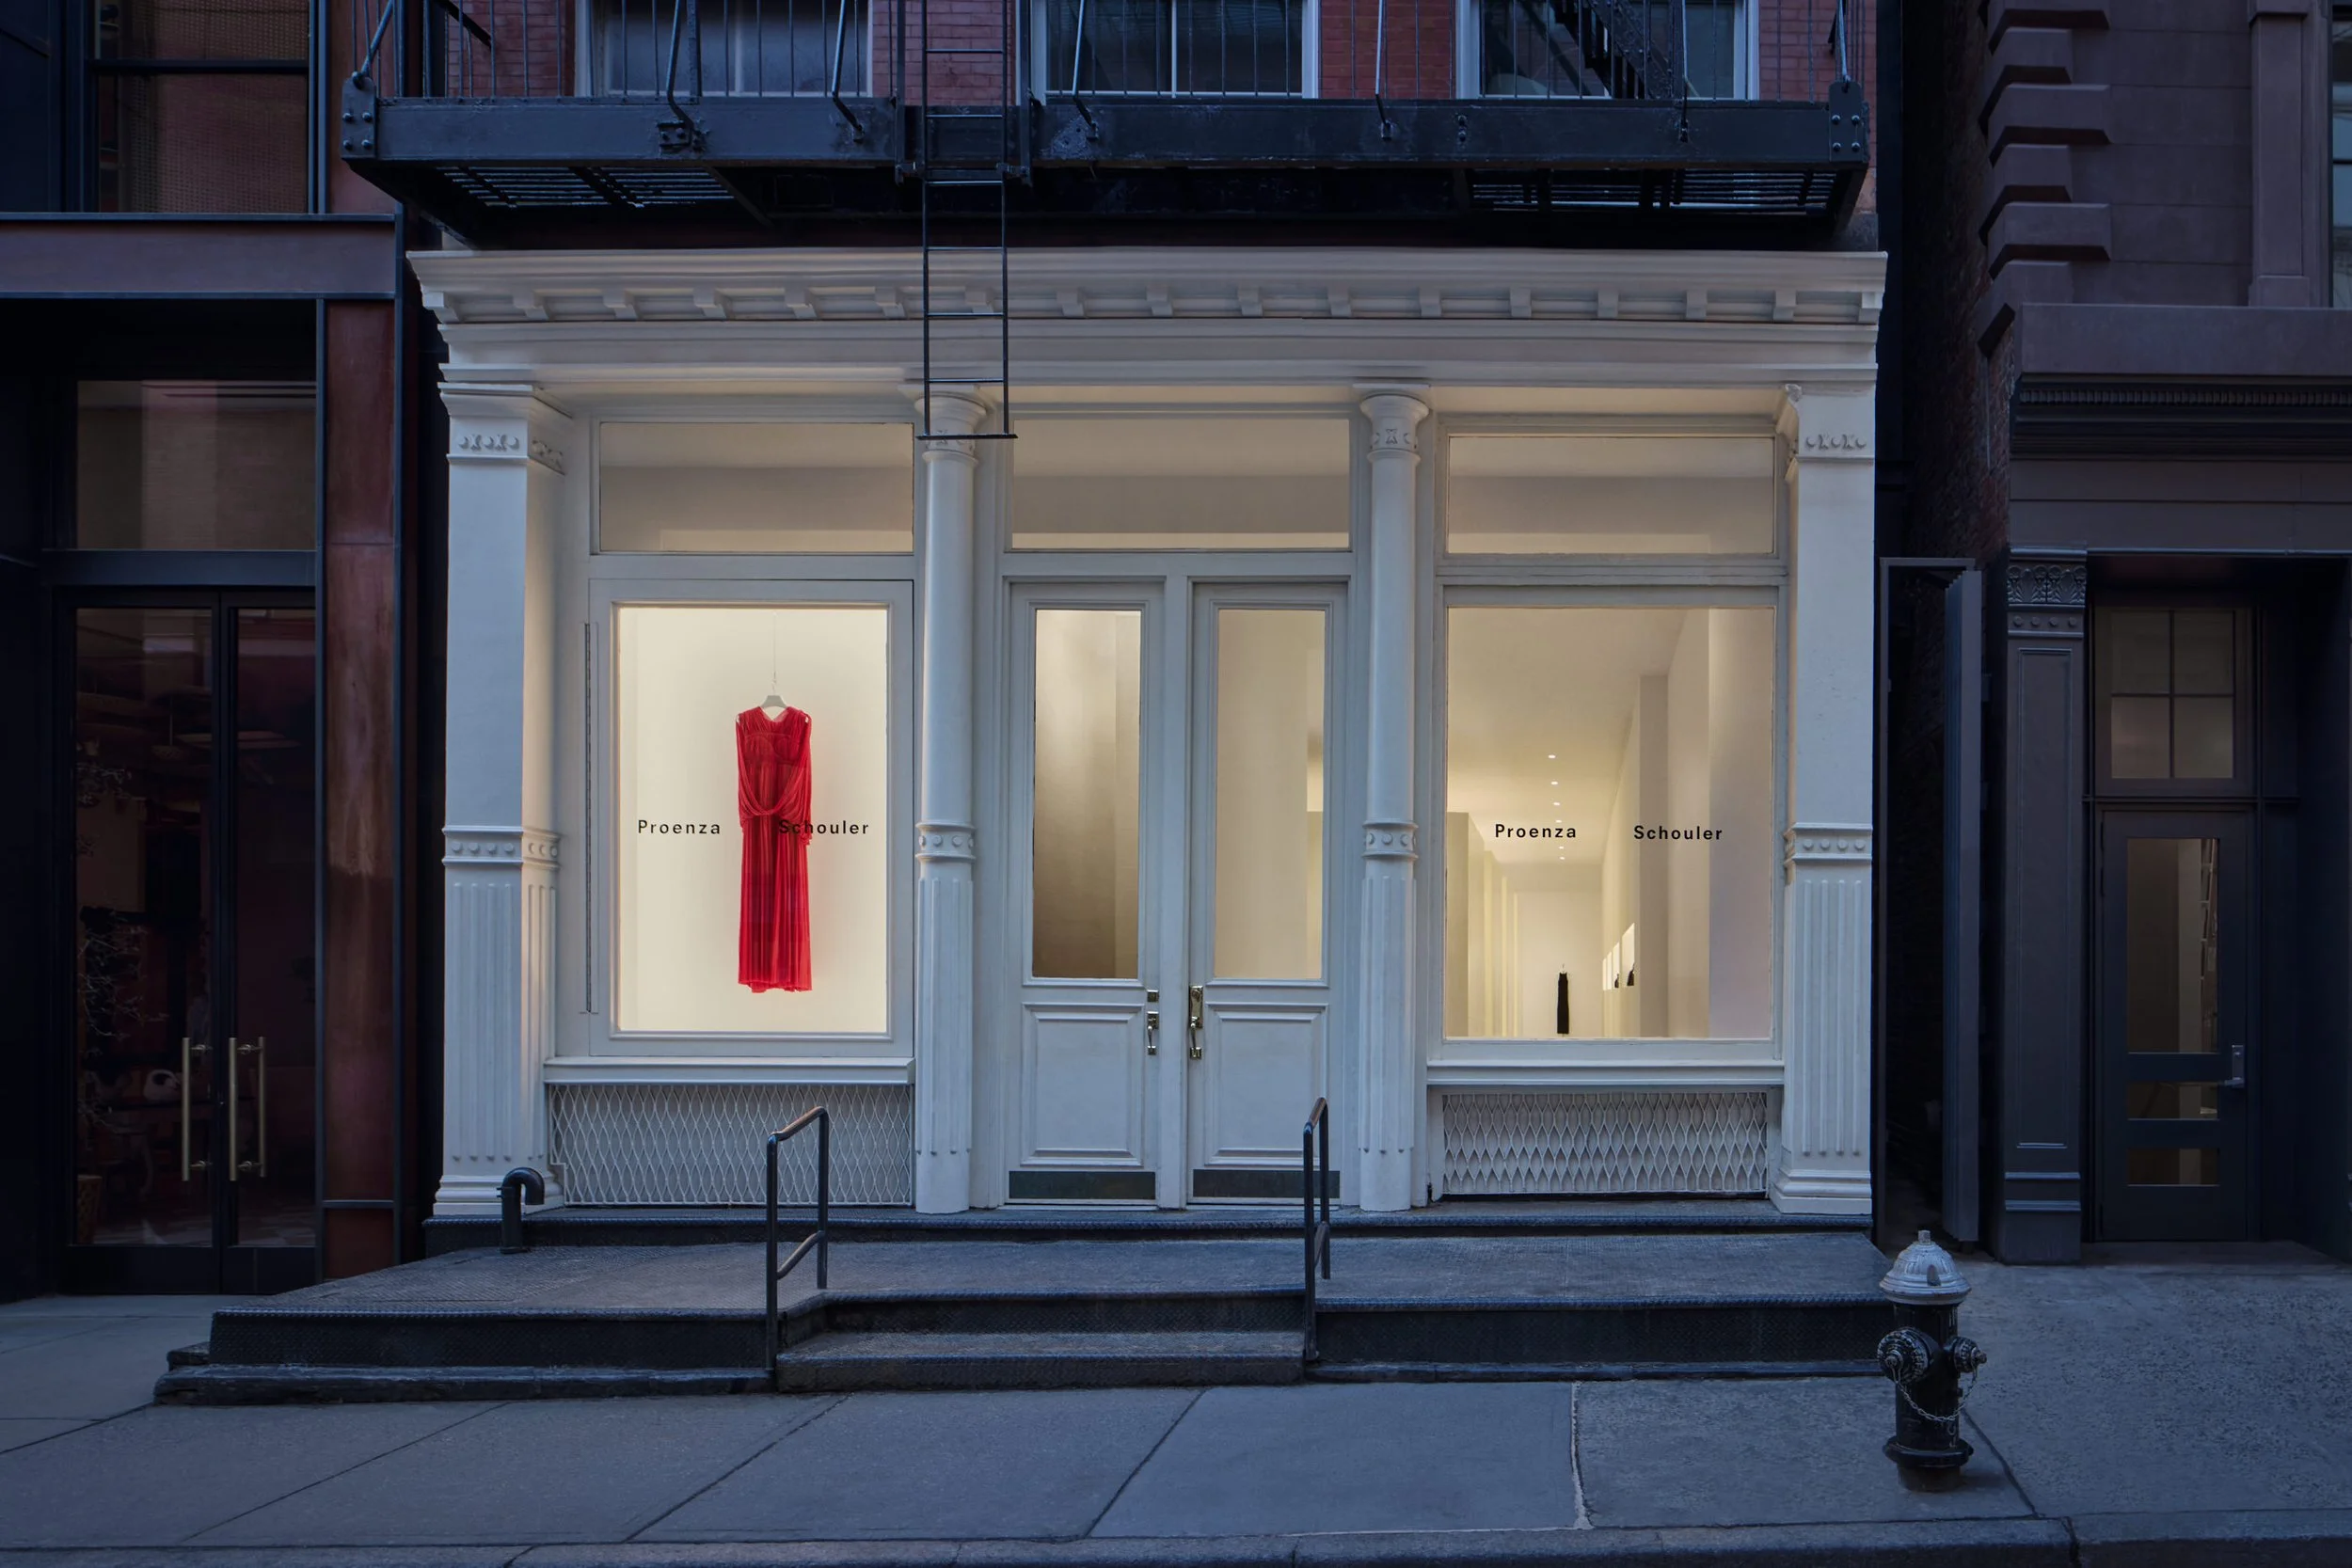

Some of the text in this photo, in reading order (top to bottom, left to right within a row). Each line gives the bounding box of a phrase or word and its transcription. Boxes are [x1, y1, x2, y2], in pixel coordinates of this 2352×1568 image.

[638, 819, 869, 835] Proenza Schouler
[1495, 824, 1723, 840] Proenza Schouler
